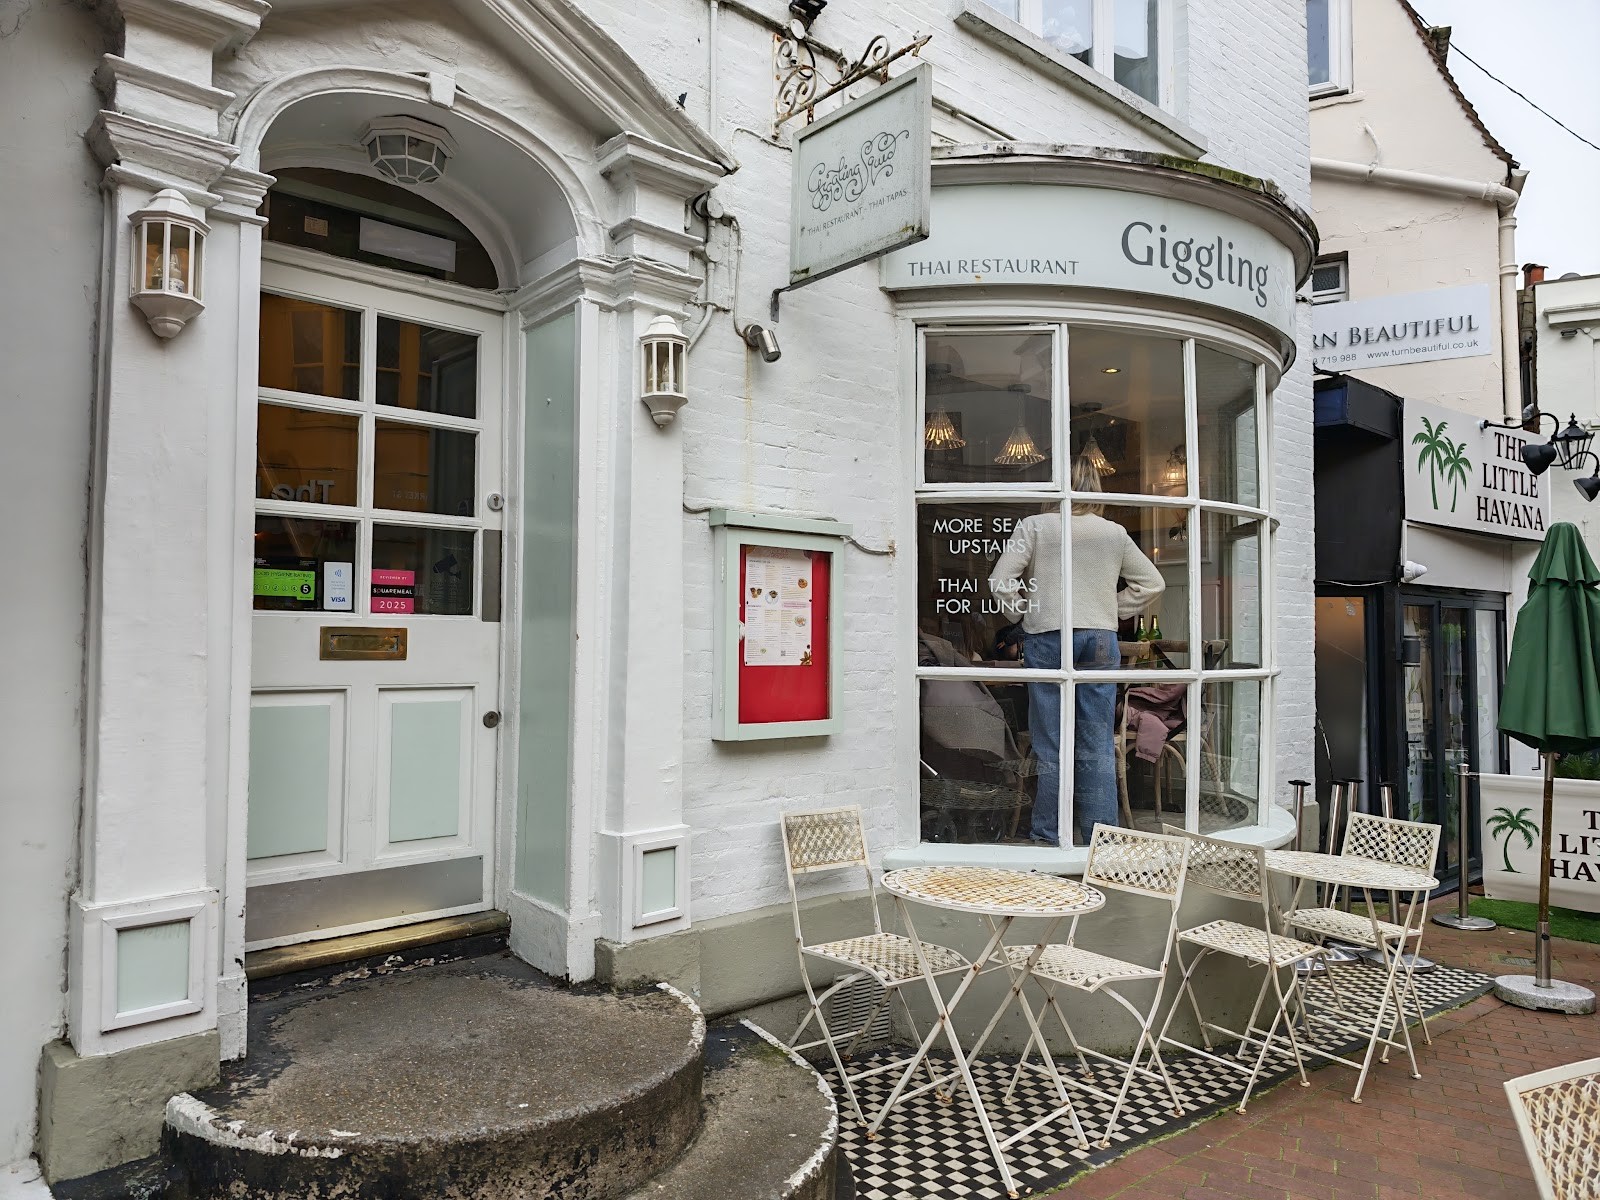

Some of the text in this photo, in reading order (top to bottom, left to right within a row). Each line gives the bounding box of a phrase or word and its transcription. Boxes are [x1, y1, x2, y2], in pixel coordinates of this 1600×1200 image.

[808, 157, 862, 211] Giggling
[808, 225, 822, 236] THAI
[822, 206, 863, 230] RESTAURANT
[869, 199, 885, 210] THAI
[886, 189, 908, 205] TAPAS
[907, 258, 1080, 277] THAI RESTAURANT
[1121, 221, 1269, 308] Giggling
[1349, 315, 1480, 347] BEAUTIFUL
[1321, 355, 1338, 365] 719
[1340, 353, 1357, 363] 988
[1367, 339, 1479, 359] www.turnbeautiful.co.uk
[1482, 462, 1539, 499] LITTLE
[932, 517, 1044, 534] MORE SEATS
[1476, 495, 1545, 532] HAVANA
[949, 538, 1027, 554] UPSTAIRS
[938, 577, 1039, 593] THAI TAPAS
[379, 600, 406, 609] 2025
[936, 598, 1041, 614] FOR LUNCH
